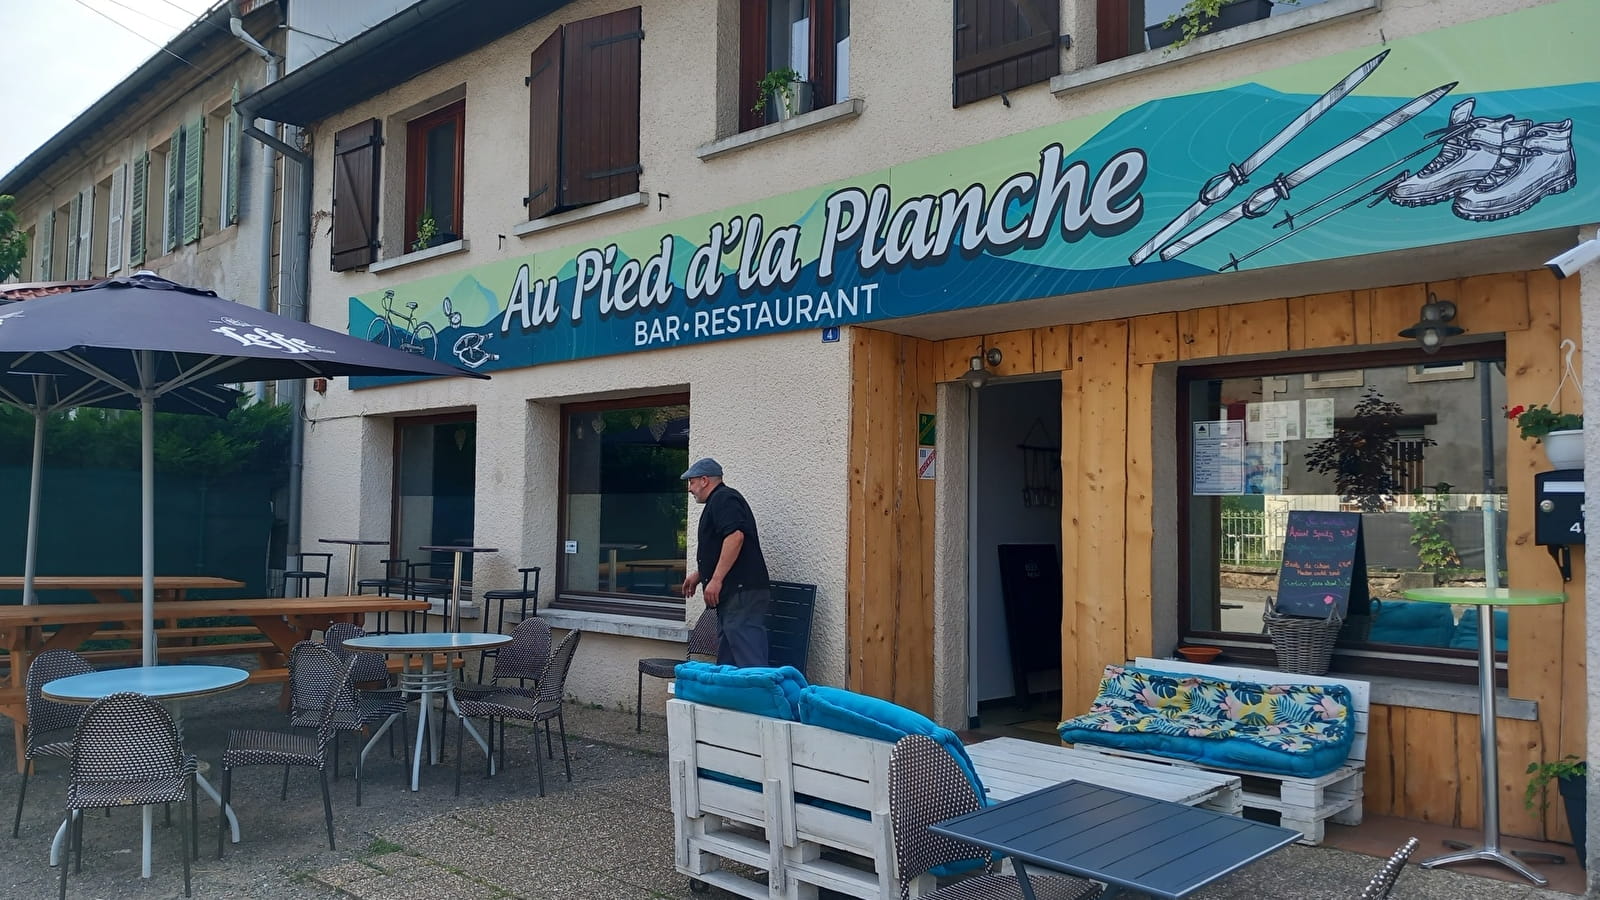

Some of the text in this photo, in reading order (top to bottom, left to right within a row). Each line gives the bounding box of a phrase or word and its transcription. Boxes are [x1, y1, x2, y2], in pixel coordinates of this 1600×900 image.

[501, 264, 560, 333] Au
[571, 243, 673, 322] Pied
[817, 143, 1147, 279] Planche
[694, 283, 879, 338] RESTAURANT
[211, 326, 316, 354] Leffe
[826, 328, 833, 340] 4
[921, 415, 928, 425] R
